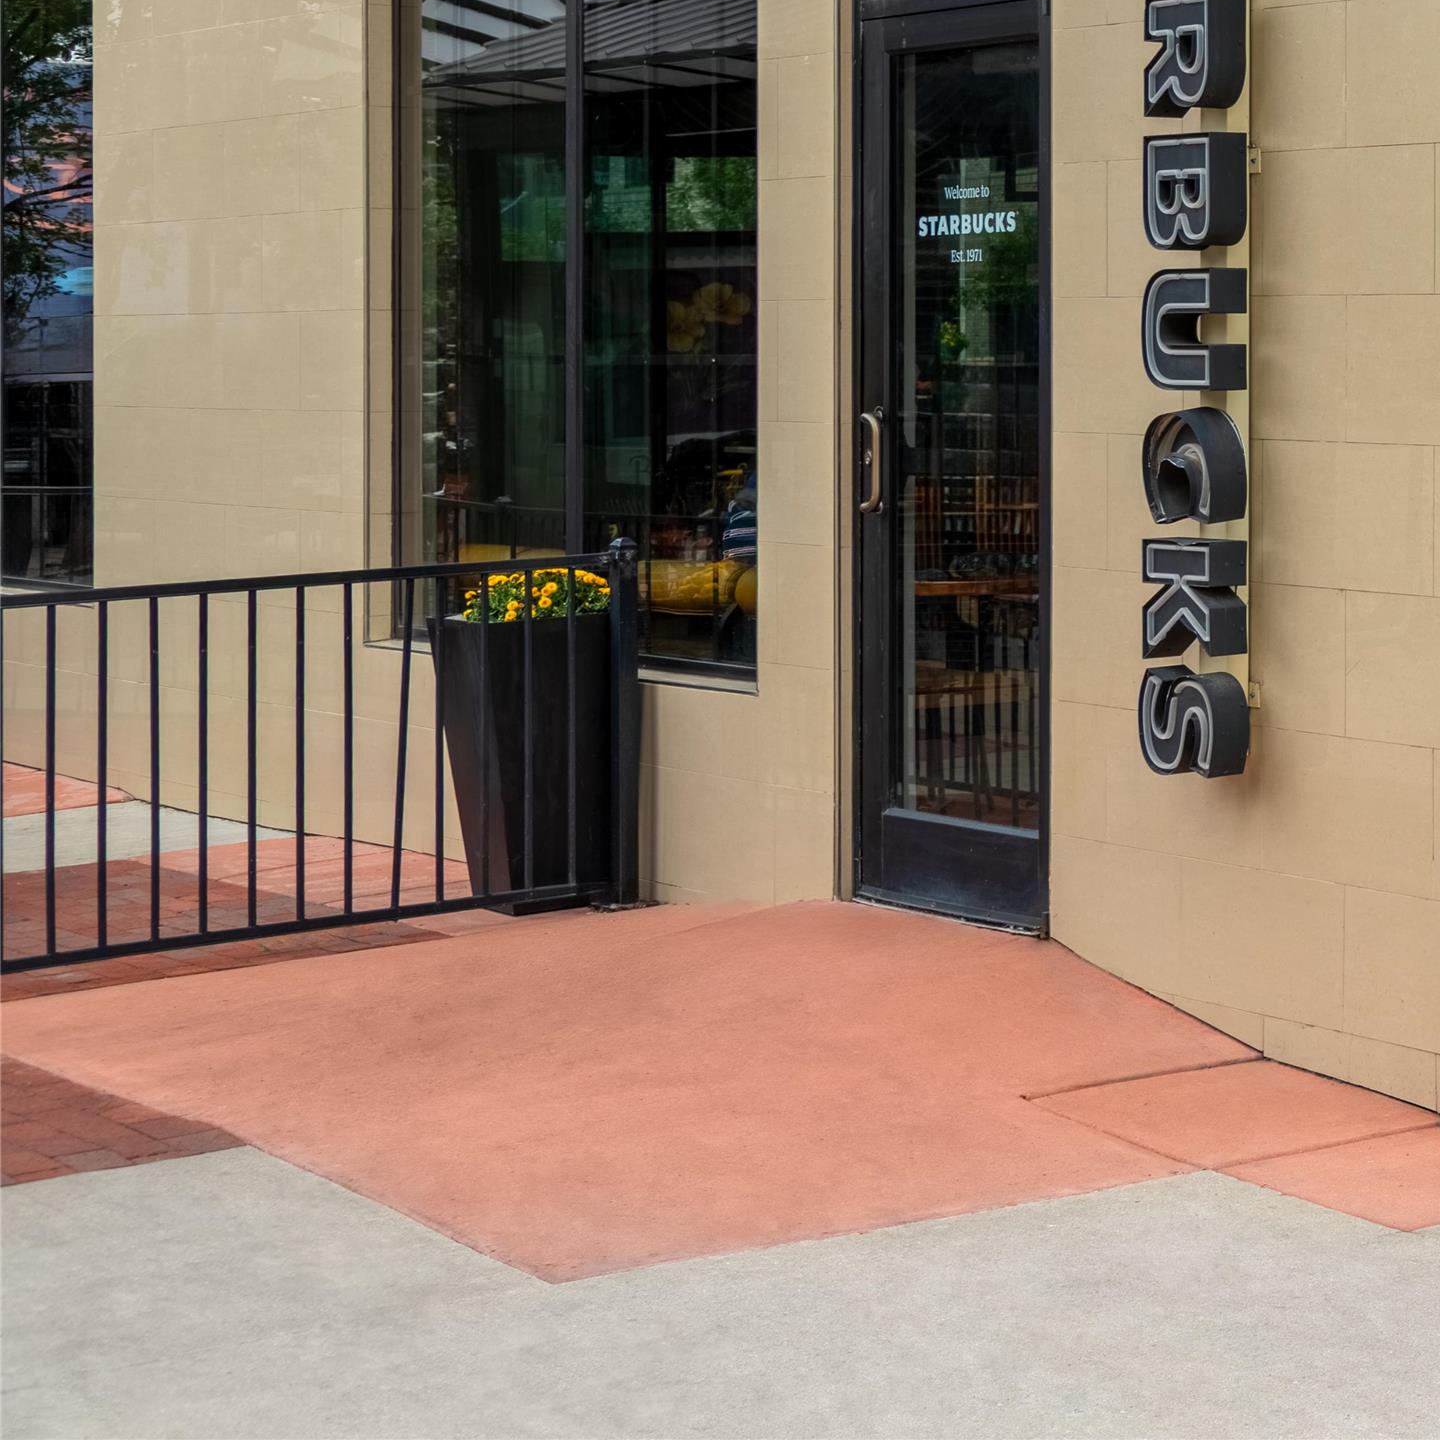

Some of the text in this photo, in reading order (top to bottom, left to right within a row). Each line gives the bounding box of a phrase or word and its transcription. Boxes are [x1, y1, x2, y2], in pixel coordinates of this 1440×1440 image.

[944, 184, 990, 201] Welcome to
[918, 210, 1017, 237] STARBUCKS
[951, 249, 983, 263] Est. 1971
